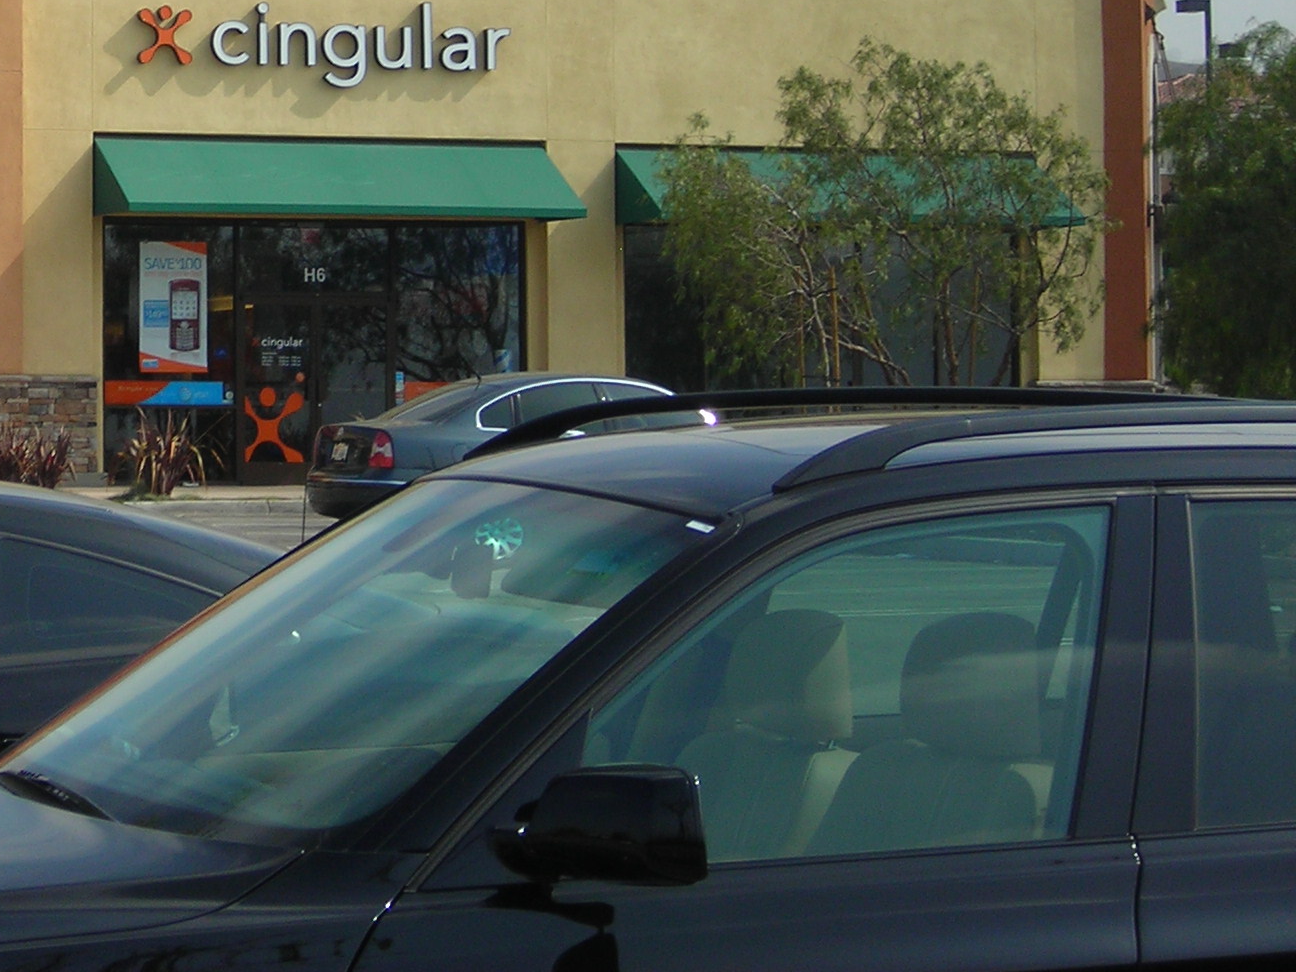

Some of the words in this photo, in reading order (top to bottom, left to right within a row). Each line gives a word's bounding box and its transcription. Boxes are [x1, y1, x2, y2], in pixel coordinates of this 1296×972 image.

[211, 2, 511, 88] cingular
[144, 257, 174, 270] SAVE
[304, 267, 326, 283] H6
[261, 336, 303, 349] cingular
